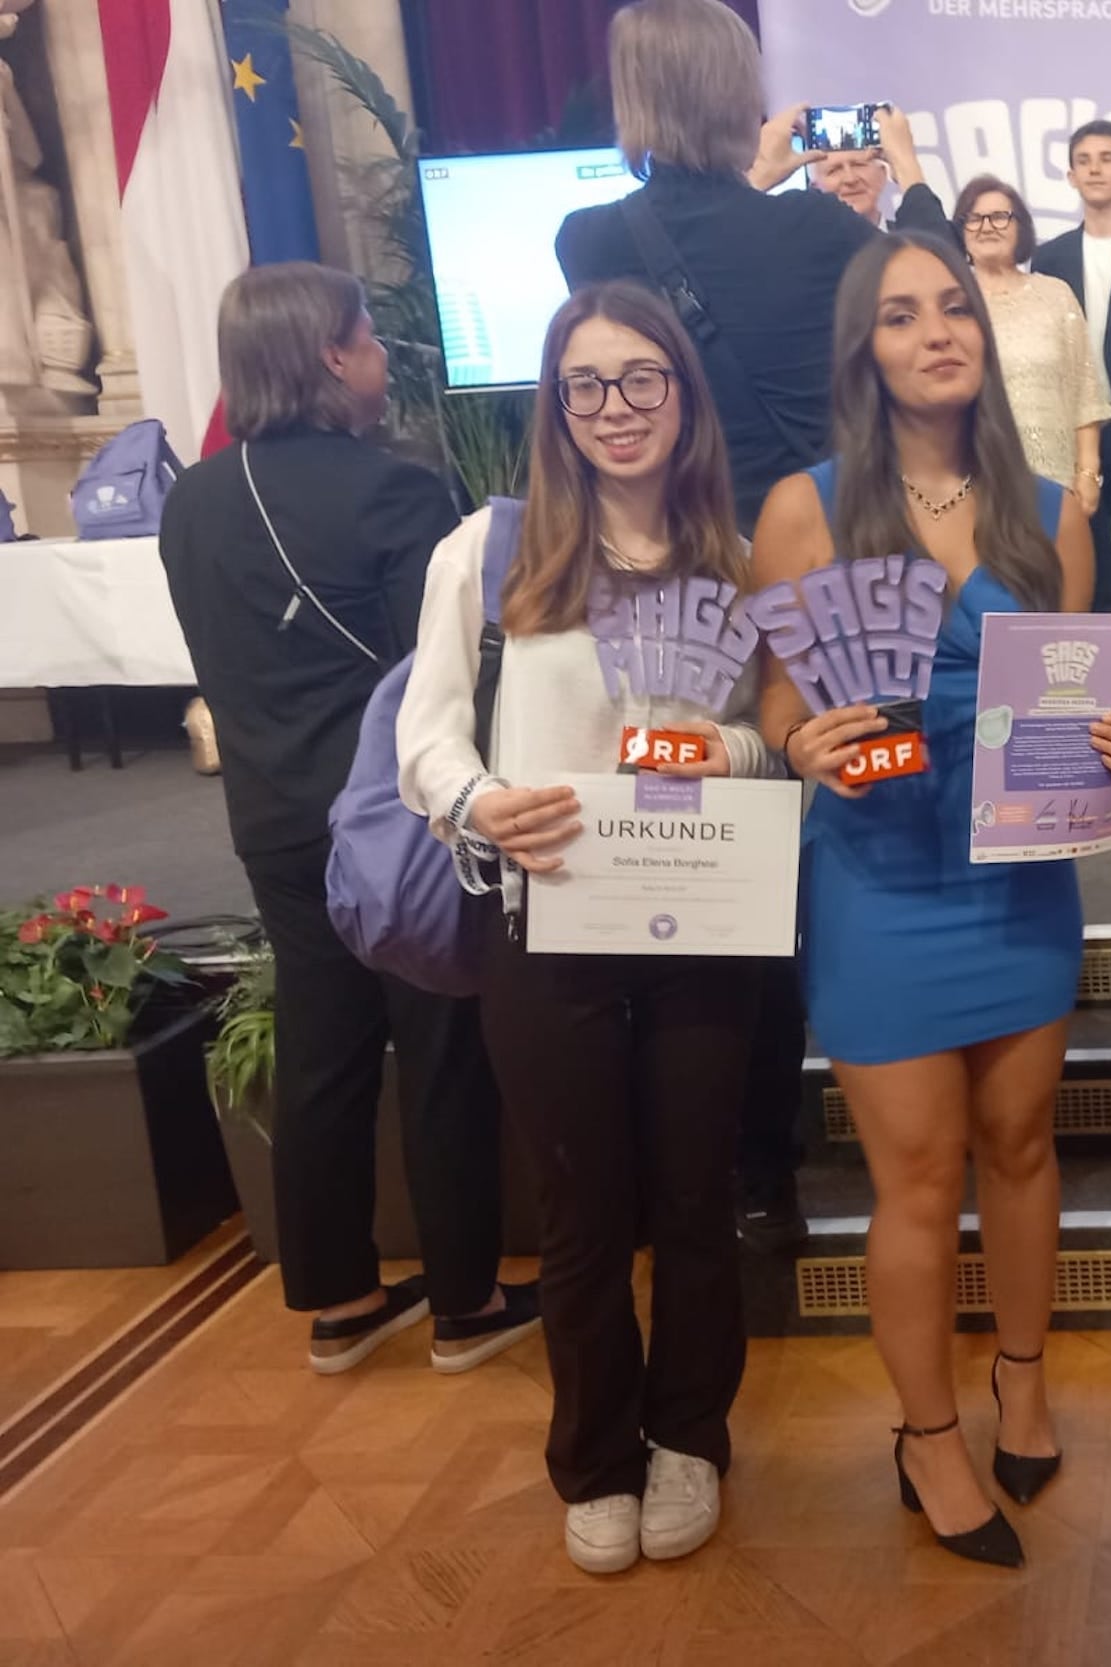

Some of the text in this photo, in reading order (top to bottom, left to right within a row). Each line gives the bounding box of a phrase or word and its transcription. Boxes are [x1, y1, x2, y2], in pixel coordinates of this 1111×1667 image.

[929, 0, 970, 16] DER
[750, 555, 947, 659] SAG'S
[626, 736, 699, 764] ORF
[845, 741, 912, 777] ORF
[598, 819, 736, 841] URKUNDE
